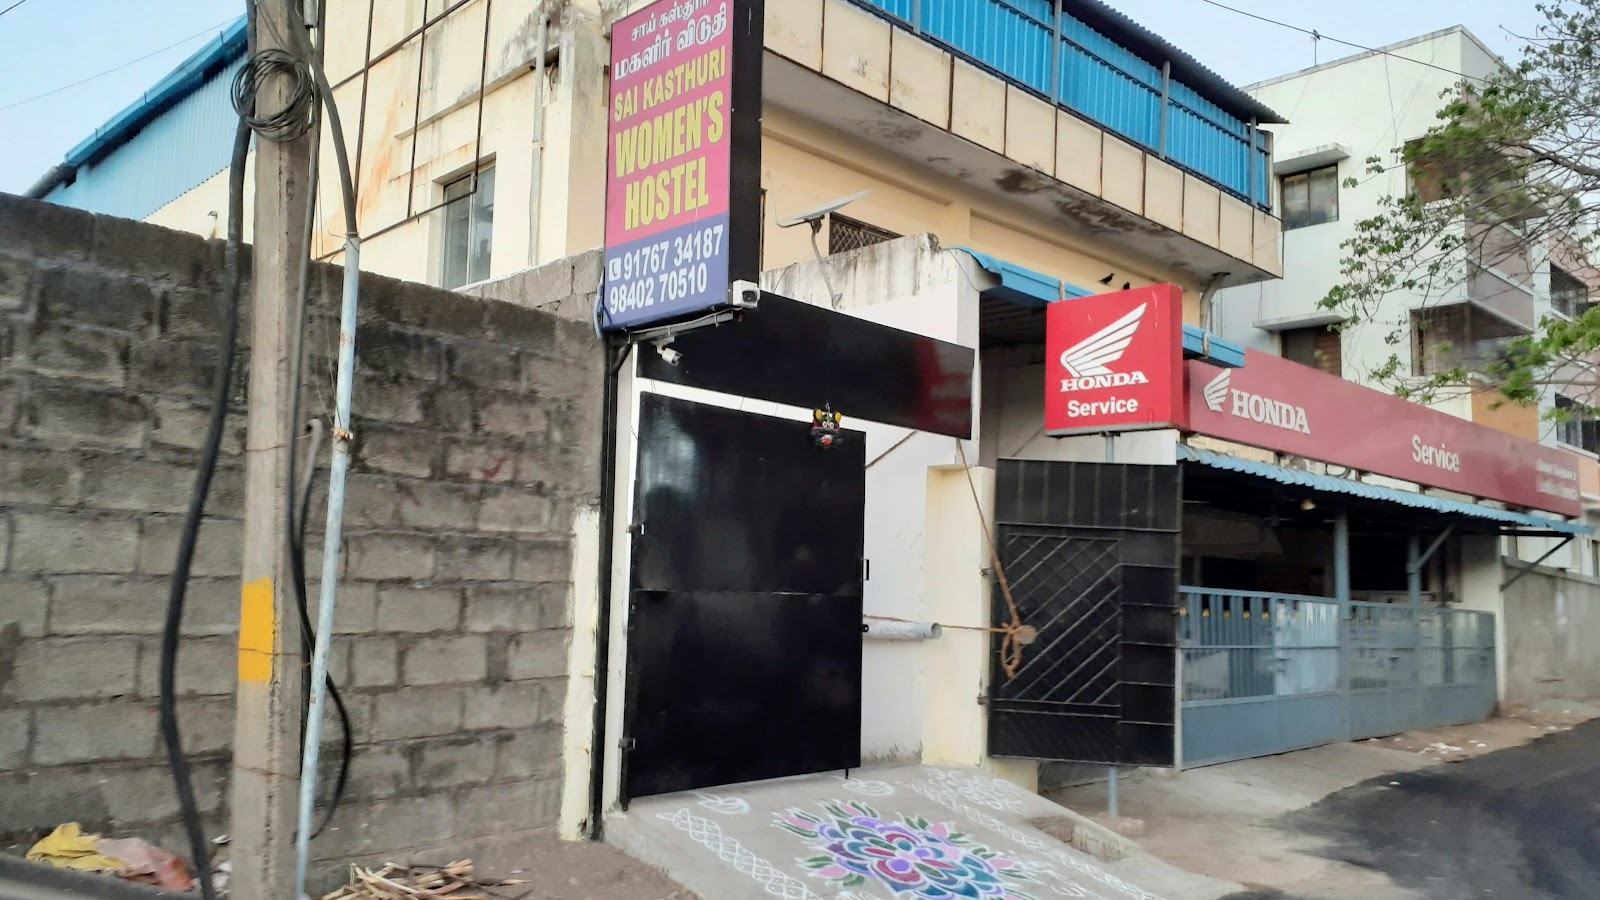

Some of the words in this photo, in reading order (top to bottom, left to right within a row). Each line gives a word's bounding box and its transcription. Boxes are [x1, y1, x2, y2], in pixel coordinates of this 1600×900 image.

[614, 29, 672, 81] மகளிர்
[676, 2, 727, 52] விடுதி
[631, 12, 656, 41] சாய்
[614, 85, 638, 122] SAI
[643, 45, 726, 110] KASTHURI
[615, 90, 724, 178] WOMEN'S
[624, 156, 709, 231] HOSTEL
[623, 240, 669, 281] 91767
[674, 224, 724, 267] 34187
[609, 278, 654, 315] 98402
[659, 262, 708, 303] 70510
[1060, 370, 1149, 393] HONDA
[1067, 396, 1139, 418] Service
[1231, 388, 1311, 434] HONDA
[1412, 434, 1460, 473] Service
